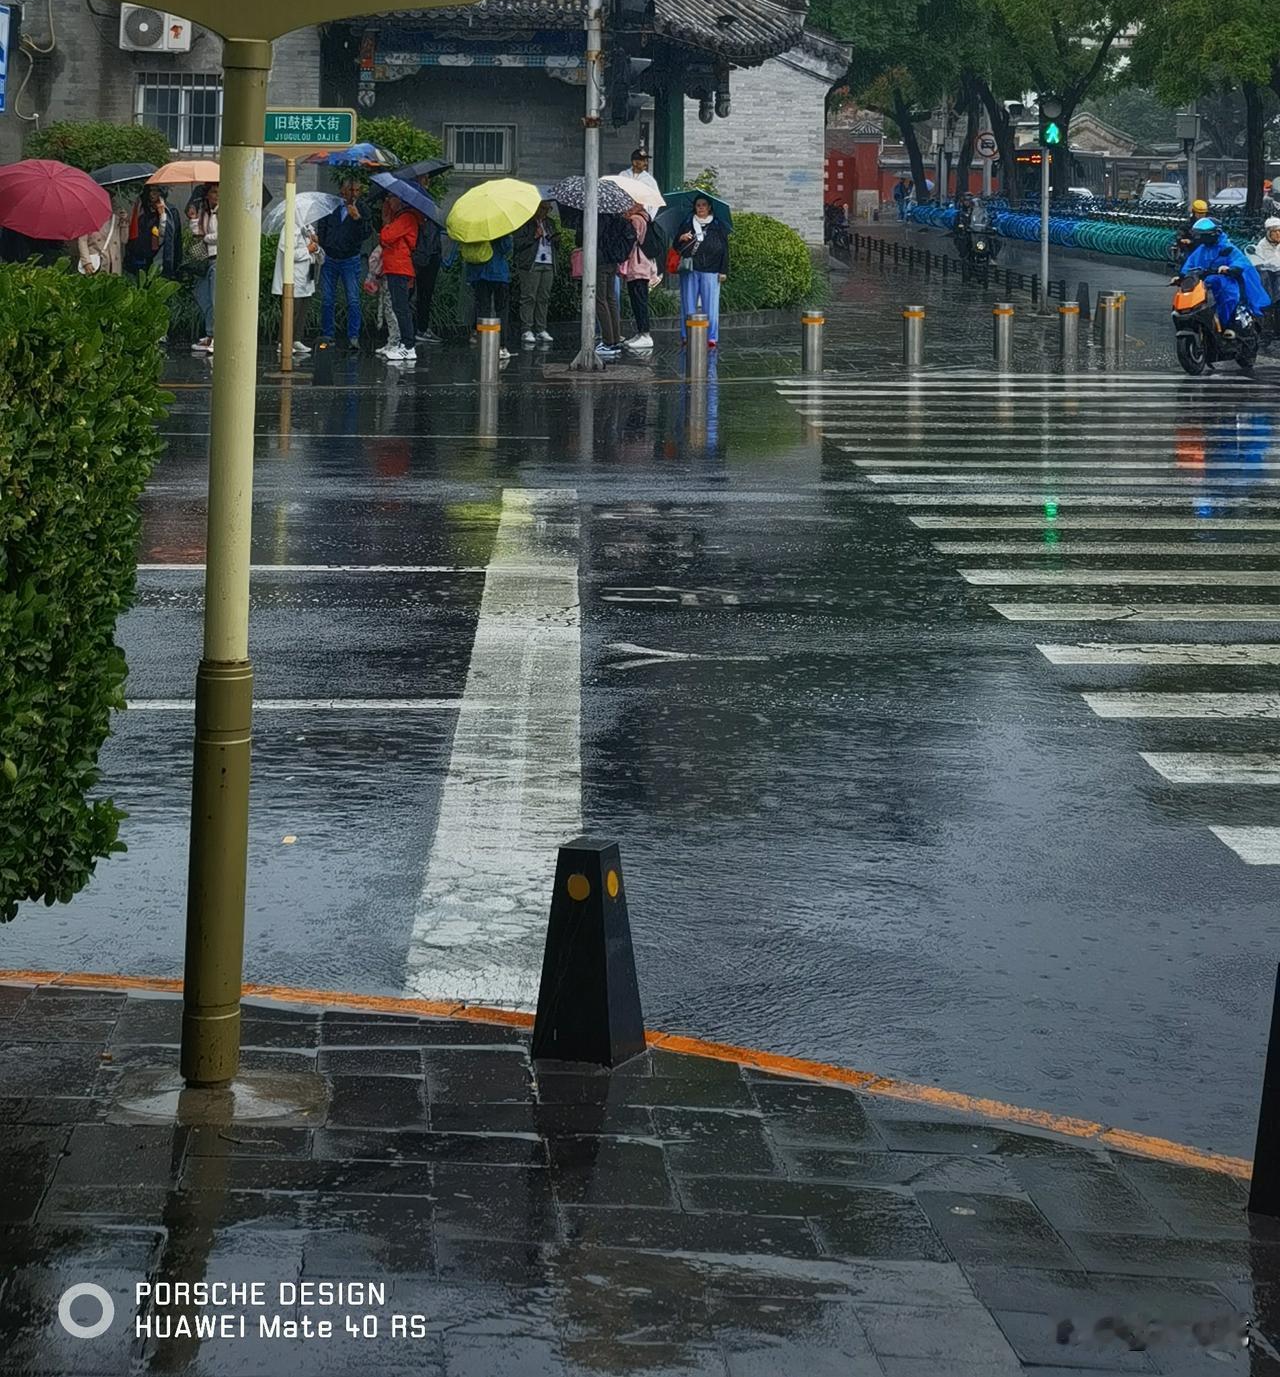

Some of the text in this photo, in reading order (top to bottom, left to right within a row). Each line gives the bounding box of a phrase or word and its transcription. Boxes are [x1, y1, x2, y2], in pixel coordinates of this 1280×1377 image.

[275, 115, 340, 131] 旧鼓楼大街
[275, 133, 341, 142] JIUGULOU DAJIE
